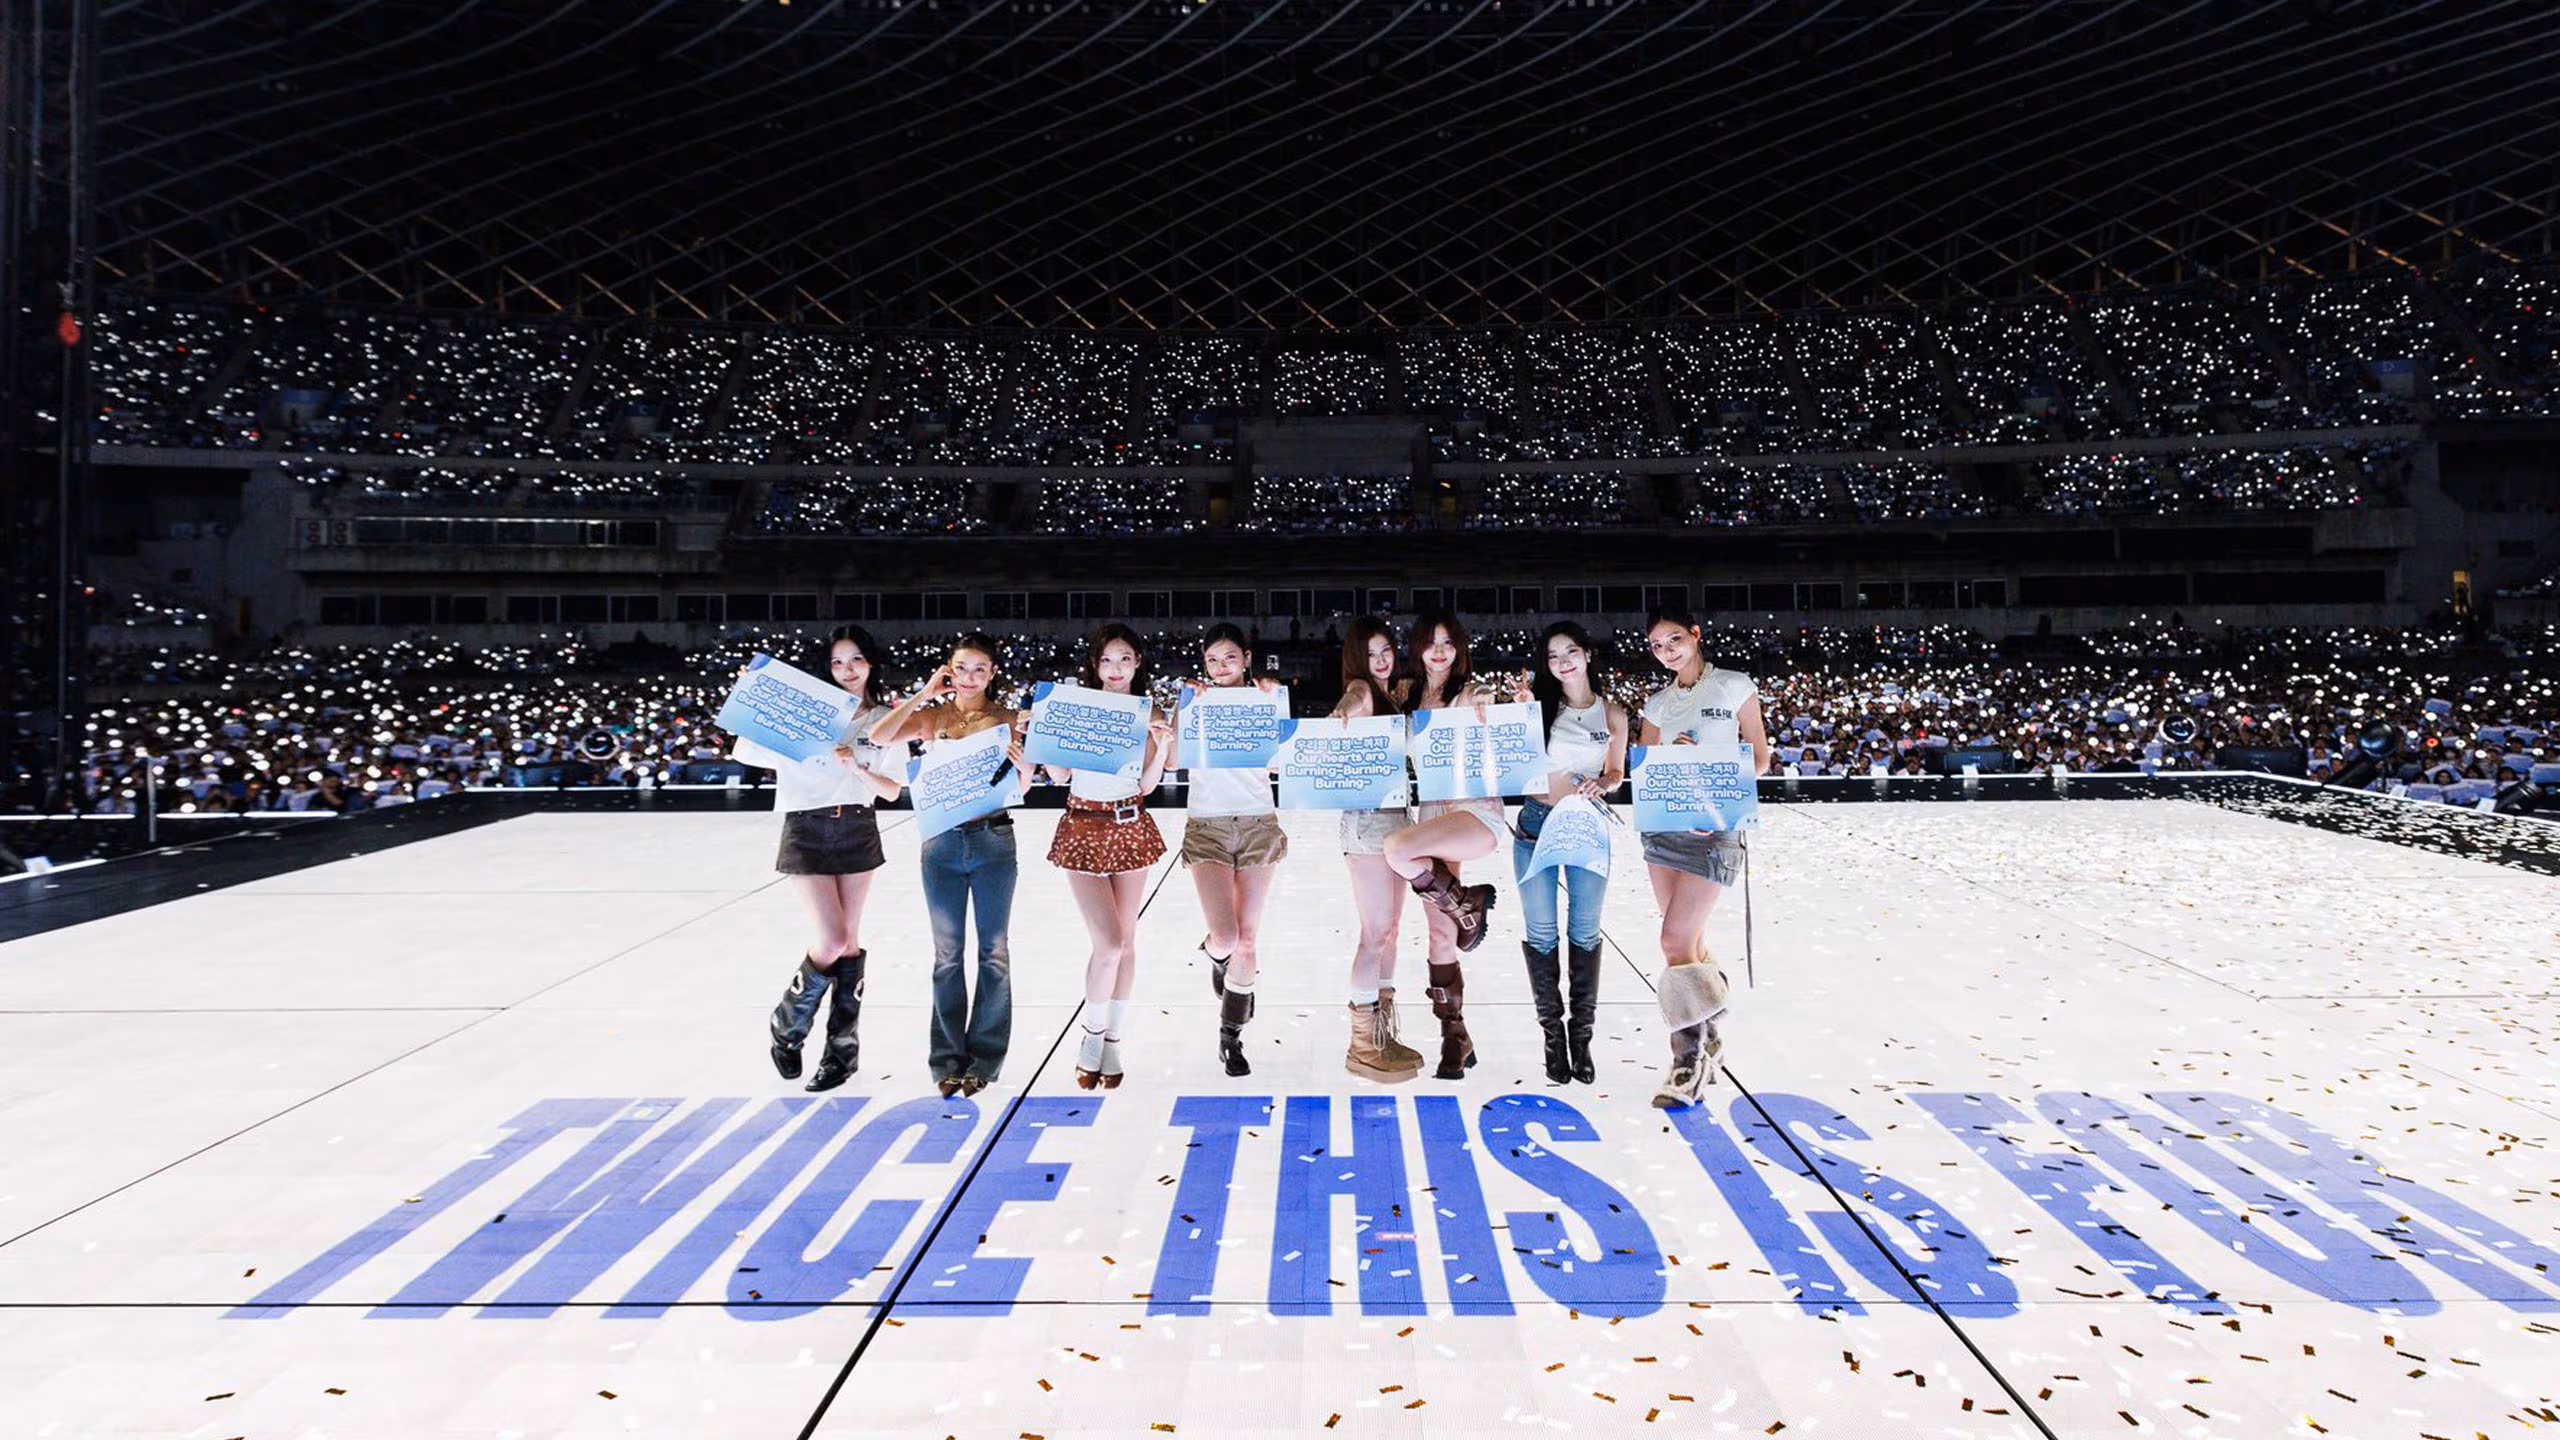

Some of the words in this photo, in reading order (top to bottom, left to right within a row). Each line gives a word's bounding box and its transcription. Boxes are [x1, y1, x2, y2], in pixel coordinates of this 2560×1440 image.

[750, 684, 772, 702] Our
[771, 694, 808, 718] hearts
[807, 712, 830, 728] are
[1045, 712, 1069, 726] Our
[1068, 716, 1108, 732] hearts
[1108, 724, 1131, 735] are
[1214, 717, 1253, 728] hearts
[1253, 717, 1274, 728] are
[1502, 738, 1525, 750] are
[1294, 751, 1320, 764] Our
[1320, 752, 1363, 764] hearts
[1363, 751, 1387, 762] are
[1646, 777, 1671, 789] Our
[1670, 776, 1712, 788] hearts
[1713, 777, 1737, 787] are
[217, 1097, 1106, 1322] TWICE
[1145, 1094, 1668, 1319] THIS
[1663, 1093, 2020, 1319] IS
[1902, 1092, 2560, 1317] FOR
